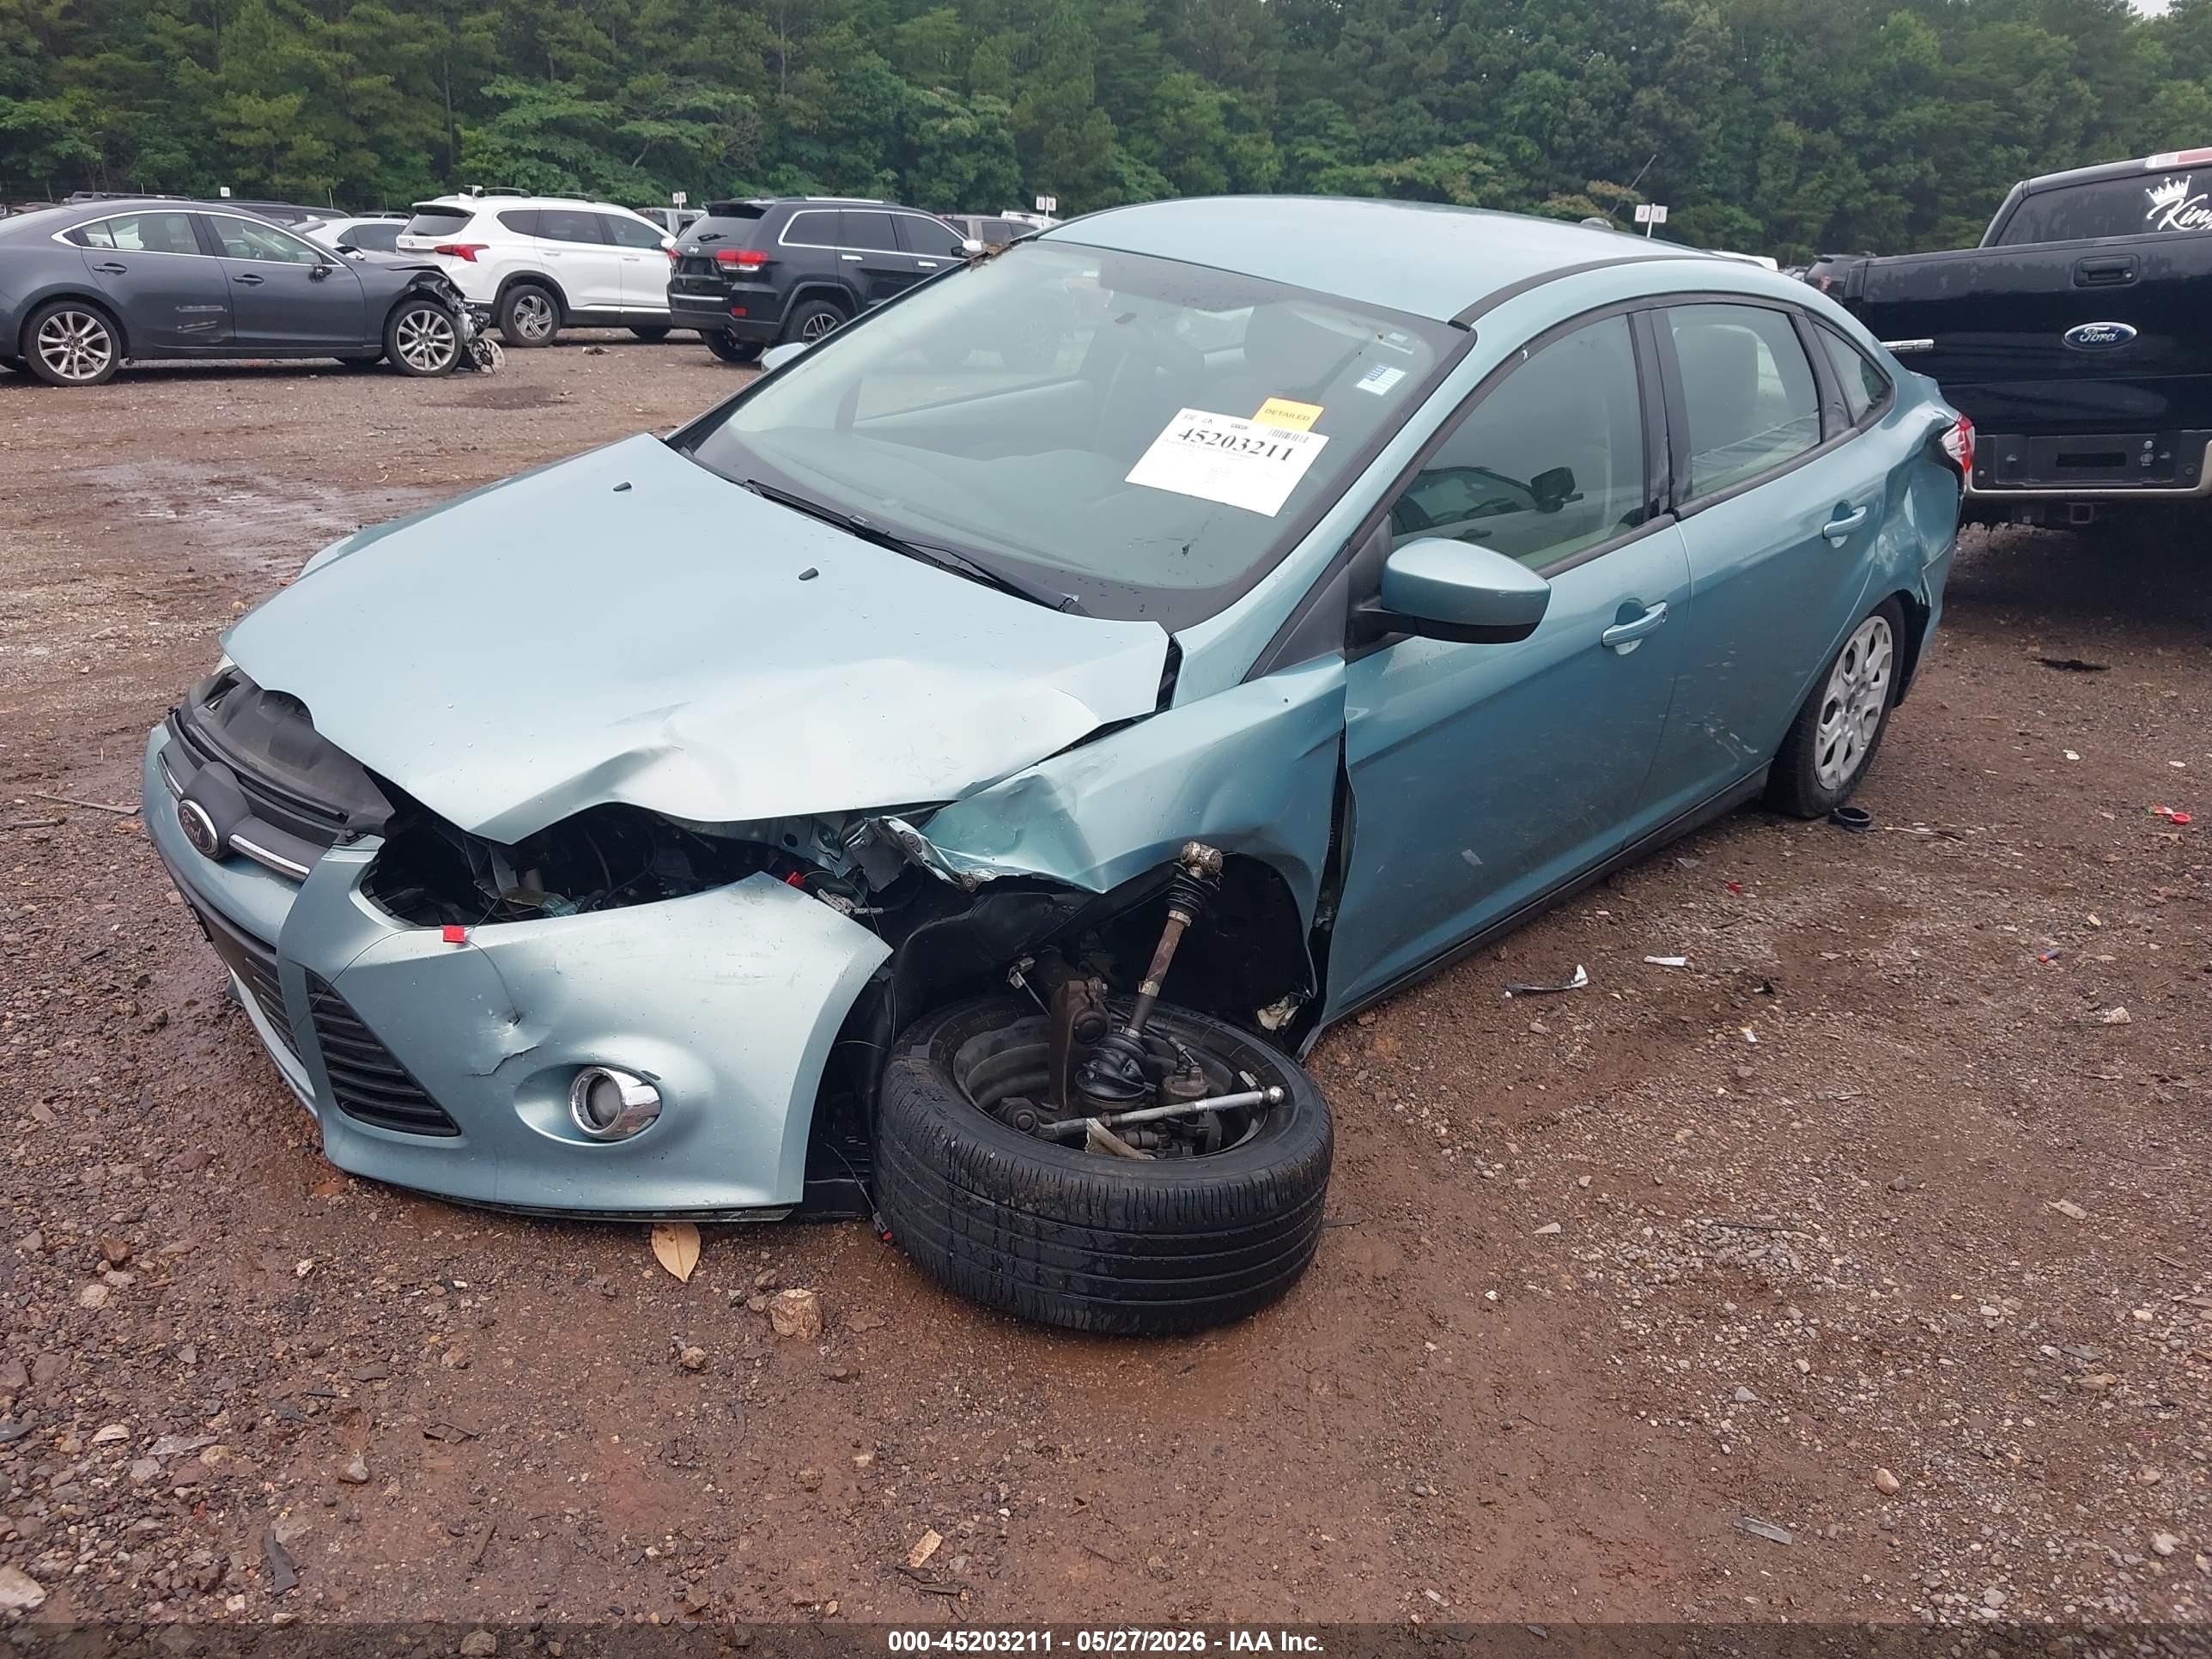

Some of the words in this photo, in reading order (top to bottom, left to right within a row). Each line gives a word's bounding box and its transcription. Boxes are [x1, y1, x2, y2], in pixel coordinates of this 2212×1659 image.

[2079, 326, 2119, 342] Ford
[1264, 408, 1311, 422] DETAILED
[1177, 427, 1295, 462] 45203211
[181, 809, 202, 845] Ford
